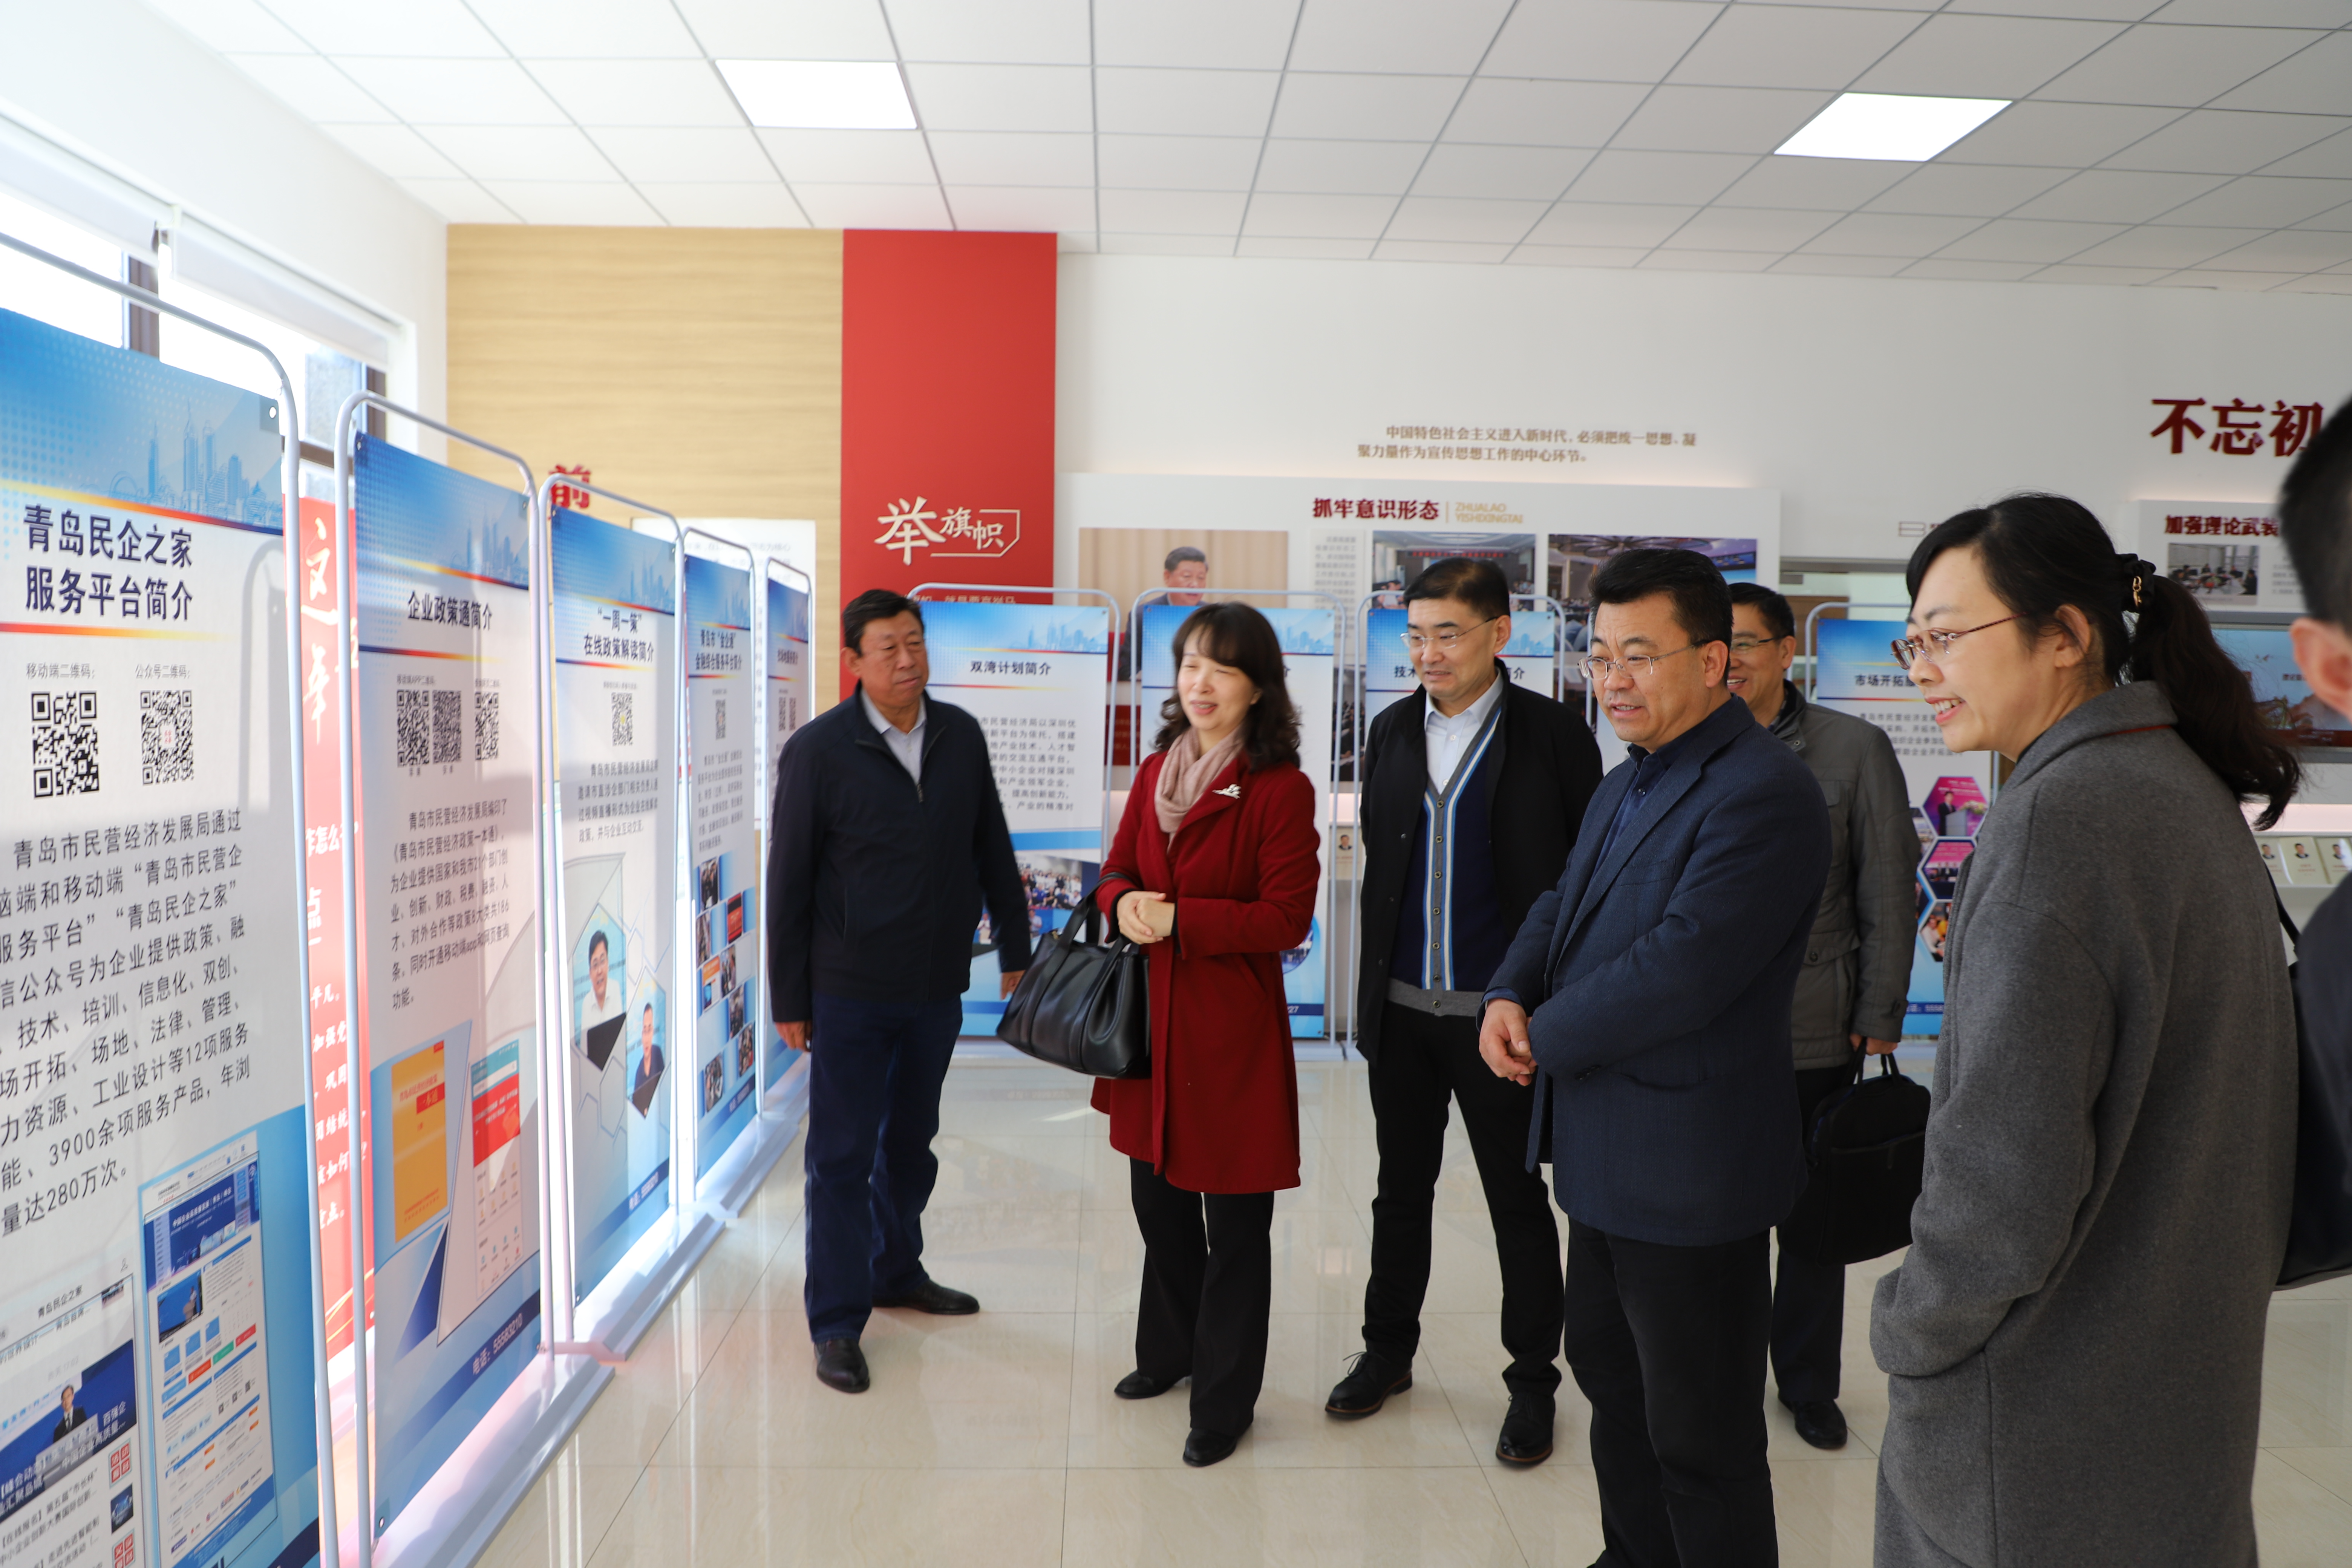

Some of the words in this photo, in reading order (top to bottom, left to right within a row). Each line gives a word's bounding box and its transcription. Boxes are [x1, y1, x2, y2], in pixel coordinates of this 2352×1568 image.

[2150, 398, 2324, 457] 不忘初
[1358, 444, 1586, 462] 聚力量作为宣传思想工作的中心环节。
[1312, 498, 1439, 520] 抓牢意识形态
[1455, 502, 1506, 512] ZHUALAO
[2165, 515, 2279, 537] 加强理论武装
[23, 504, 193, 568] 青岛民企之家
[874, 496, 1004, 566] 举旗帜
[26, 565, 193, 621] 服务平台简介
[407, 590, 493, 631] 企业政策通简介
[584, 633, 654, 662] 在线政策解读简介
[971, 660, 1051, 676] 双湾计划简介
[409, 798, 507, 831] 青岛市民营经济发展局编印了
[14, 806, 242, 871] 青岛市民营经济发展局通过
[392, 986, 414, 1011] 功能。
[1, 1022, 248, 1148] 力资源、工业设计等12项服务
[2, 1054, 250, 1193] 能、3900余项服务产品，年浏
[2, 1158, 126, 1238] 量达280万次。
[38, 1284, 83, 1319] 青岛民企之家
